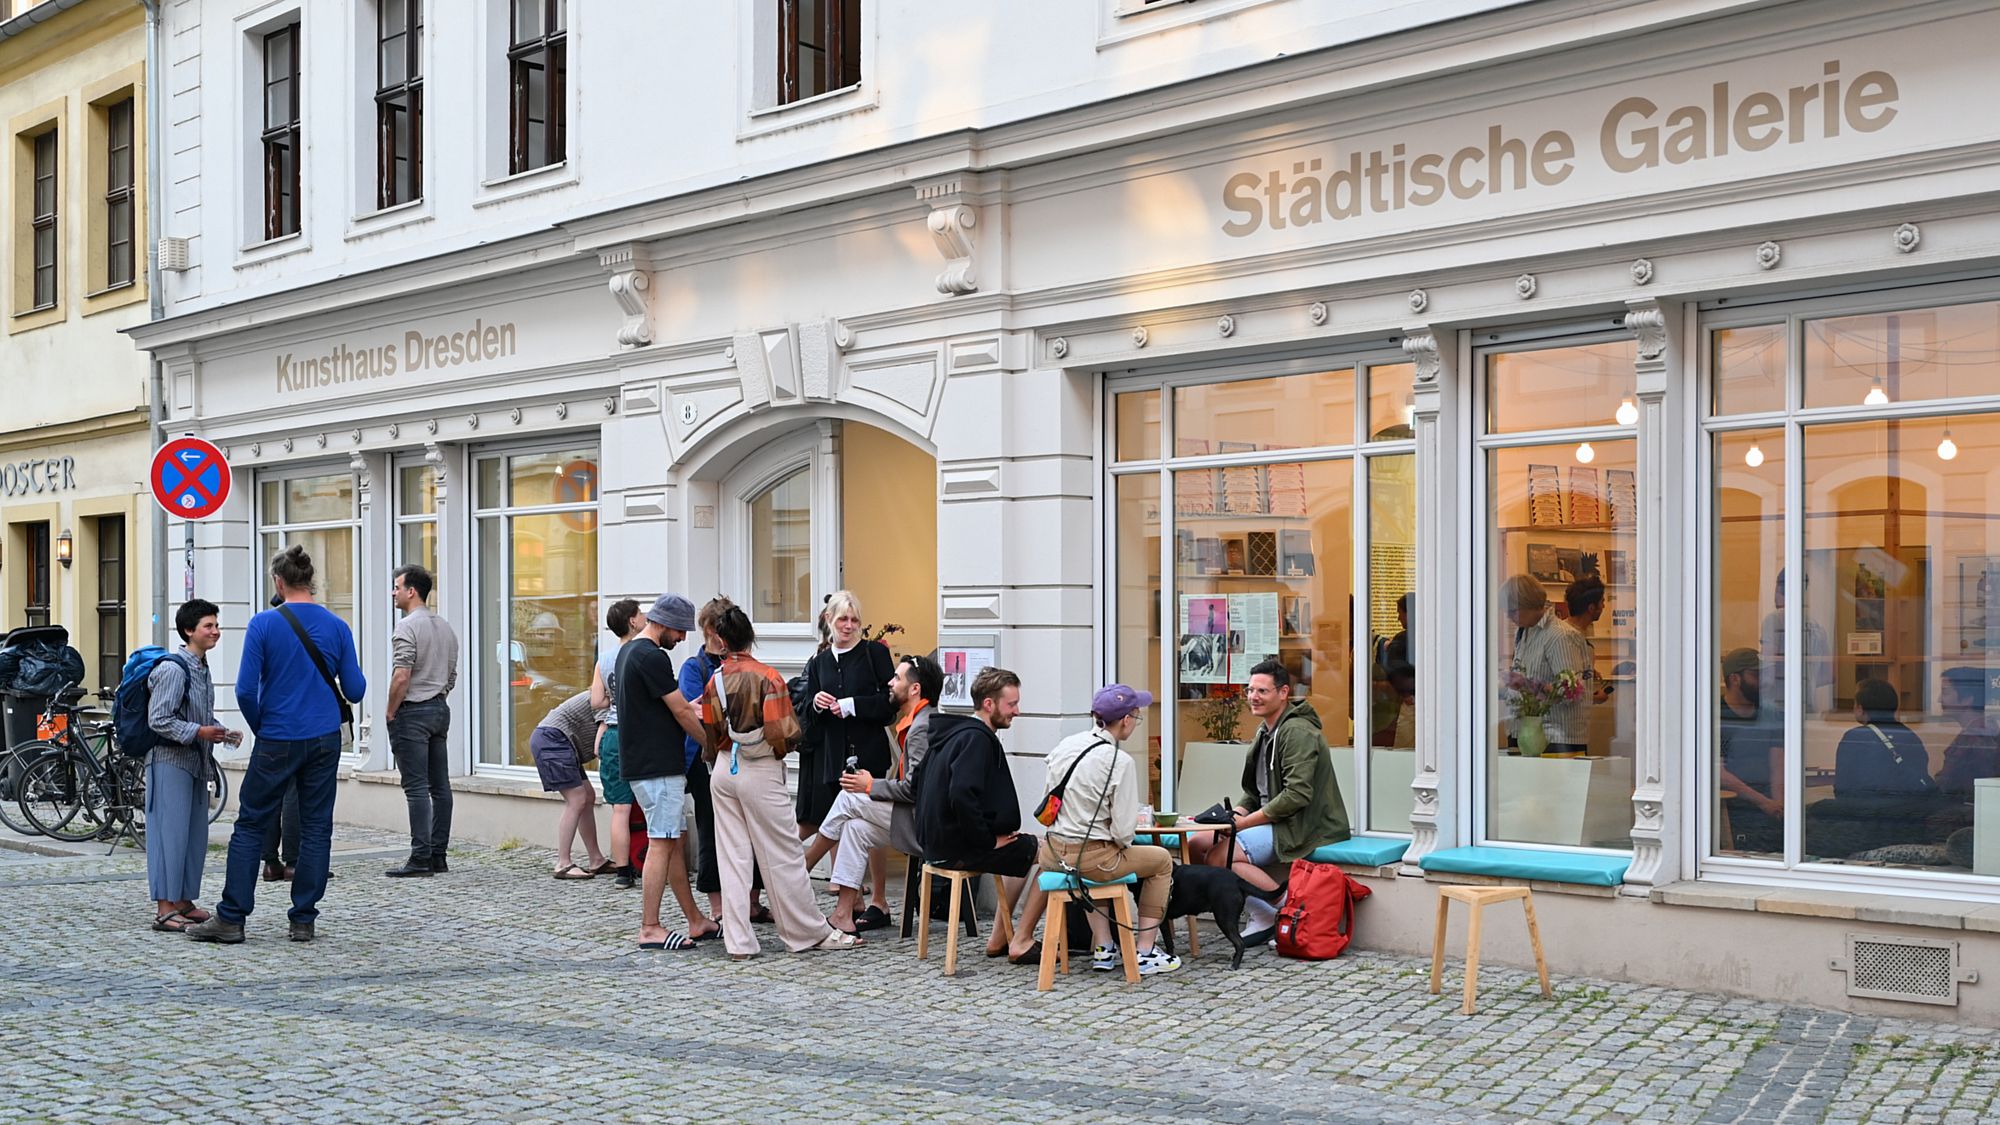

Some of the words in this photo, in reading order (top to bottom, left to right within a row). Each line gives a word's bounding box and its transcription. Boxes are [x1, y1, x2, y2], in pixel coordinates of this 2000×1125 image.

[1222, 125, 1575, 237] Städtische
[1600, 60, 1899, 173] Galerie
[276, 343, 397, 393] Kunsthaus
[405, 318, 516, 373] Dresden
[685, 405, 691, 419] 8
[0, 456, 76, 496] OSTER
